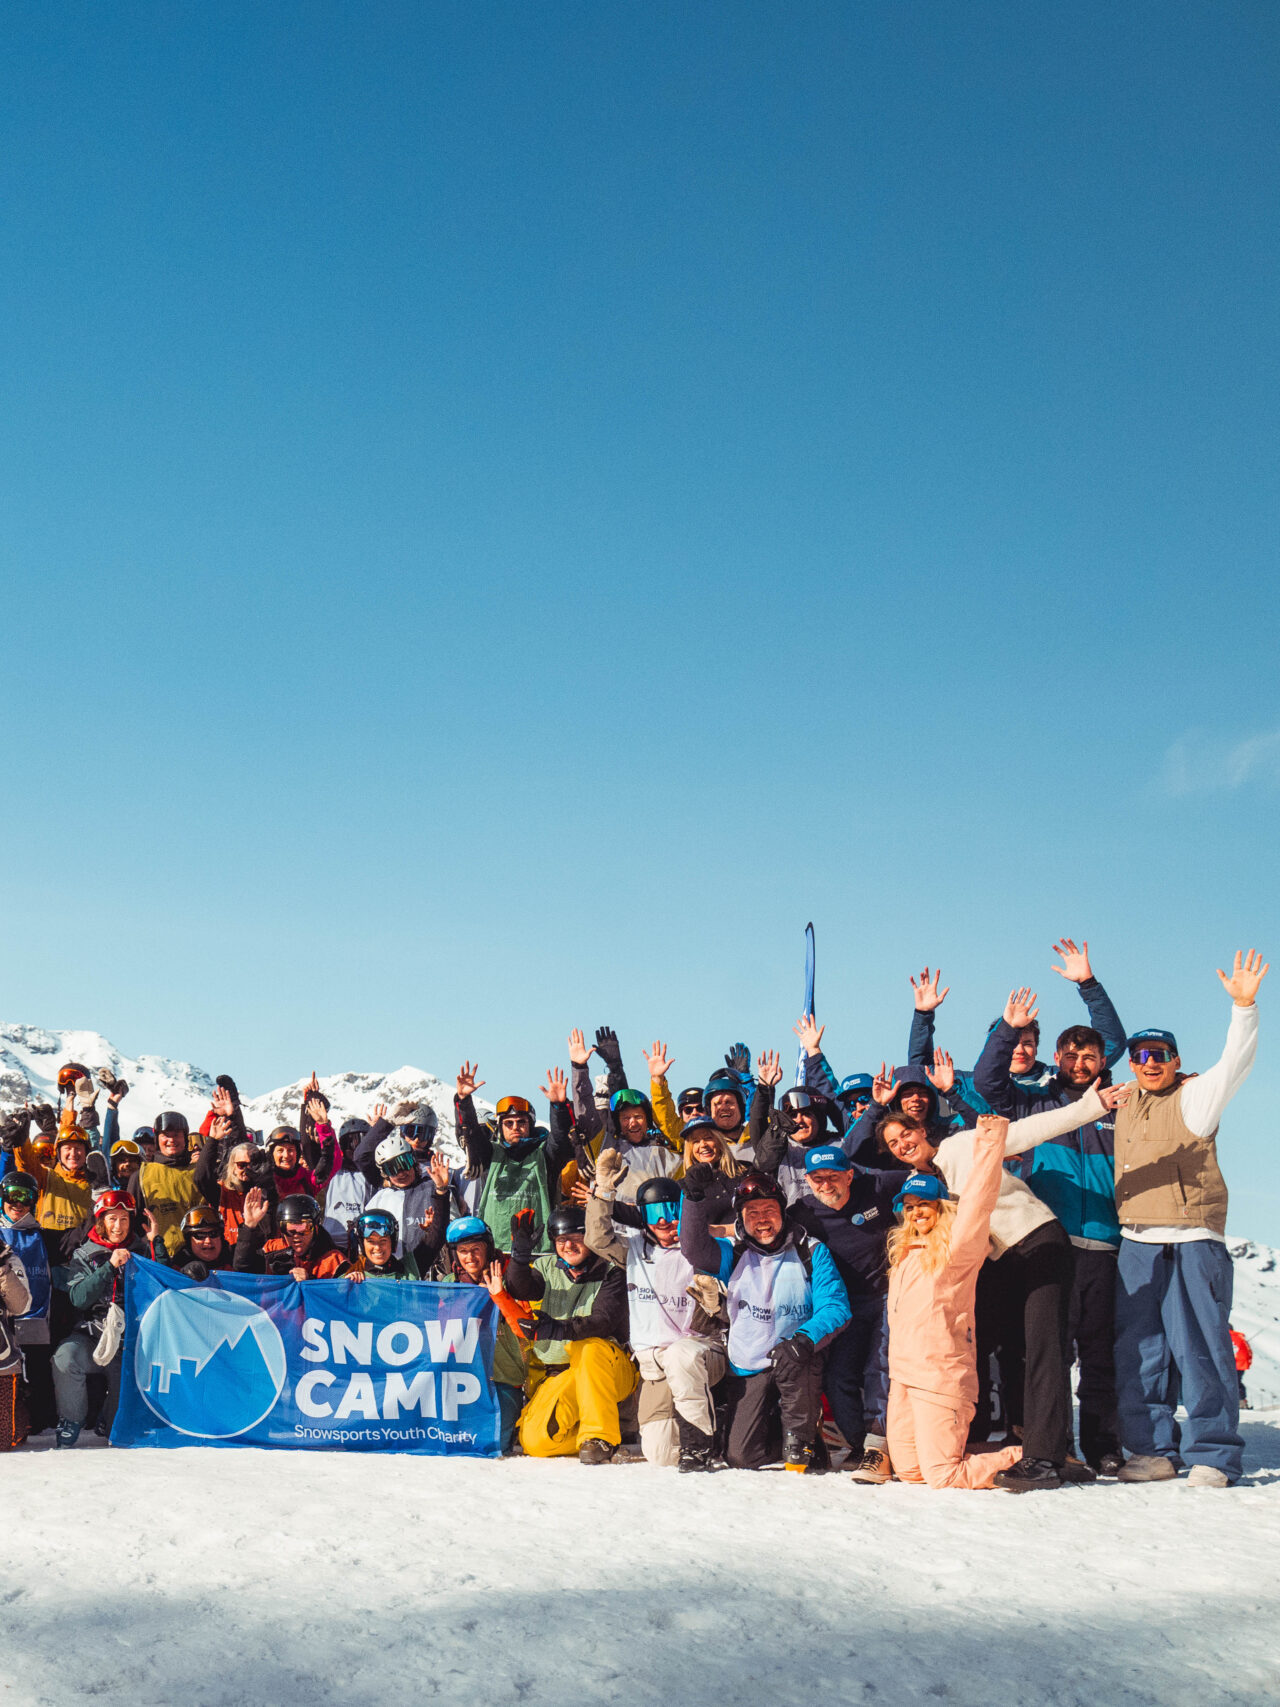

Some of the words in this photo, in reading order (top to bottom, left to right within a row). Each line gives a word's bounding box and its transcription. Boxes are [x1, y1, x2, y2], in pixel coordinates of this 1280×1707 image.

[752, 1305, 771, 1314] SNOW
[752, 1311, 772, 1321] CAMP
[299, 1317, 483, 1366] SNOW
[295, 1369, 481, 1421] CAMP
[294, 1424, 380, 1443] Snowsports
[380, 1427, 426, 1441] Youth
[427, 1426, 477, 1445] Charity
